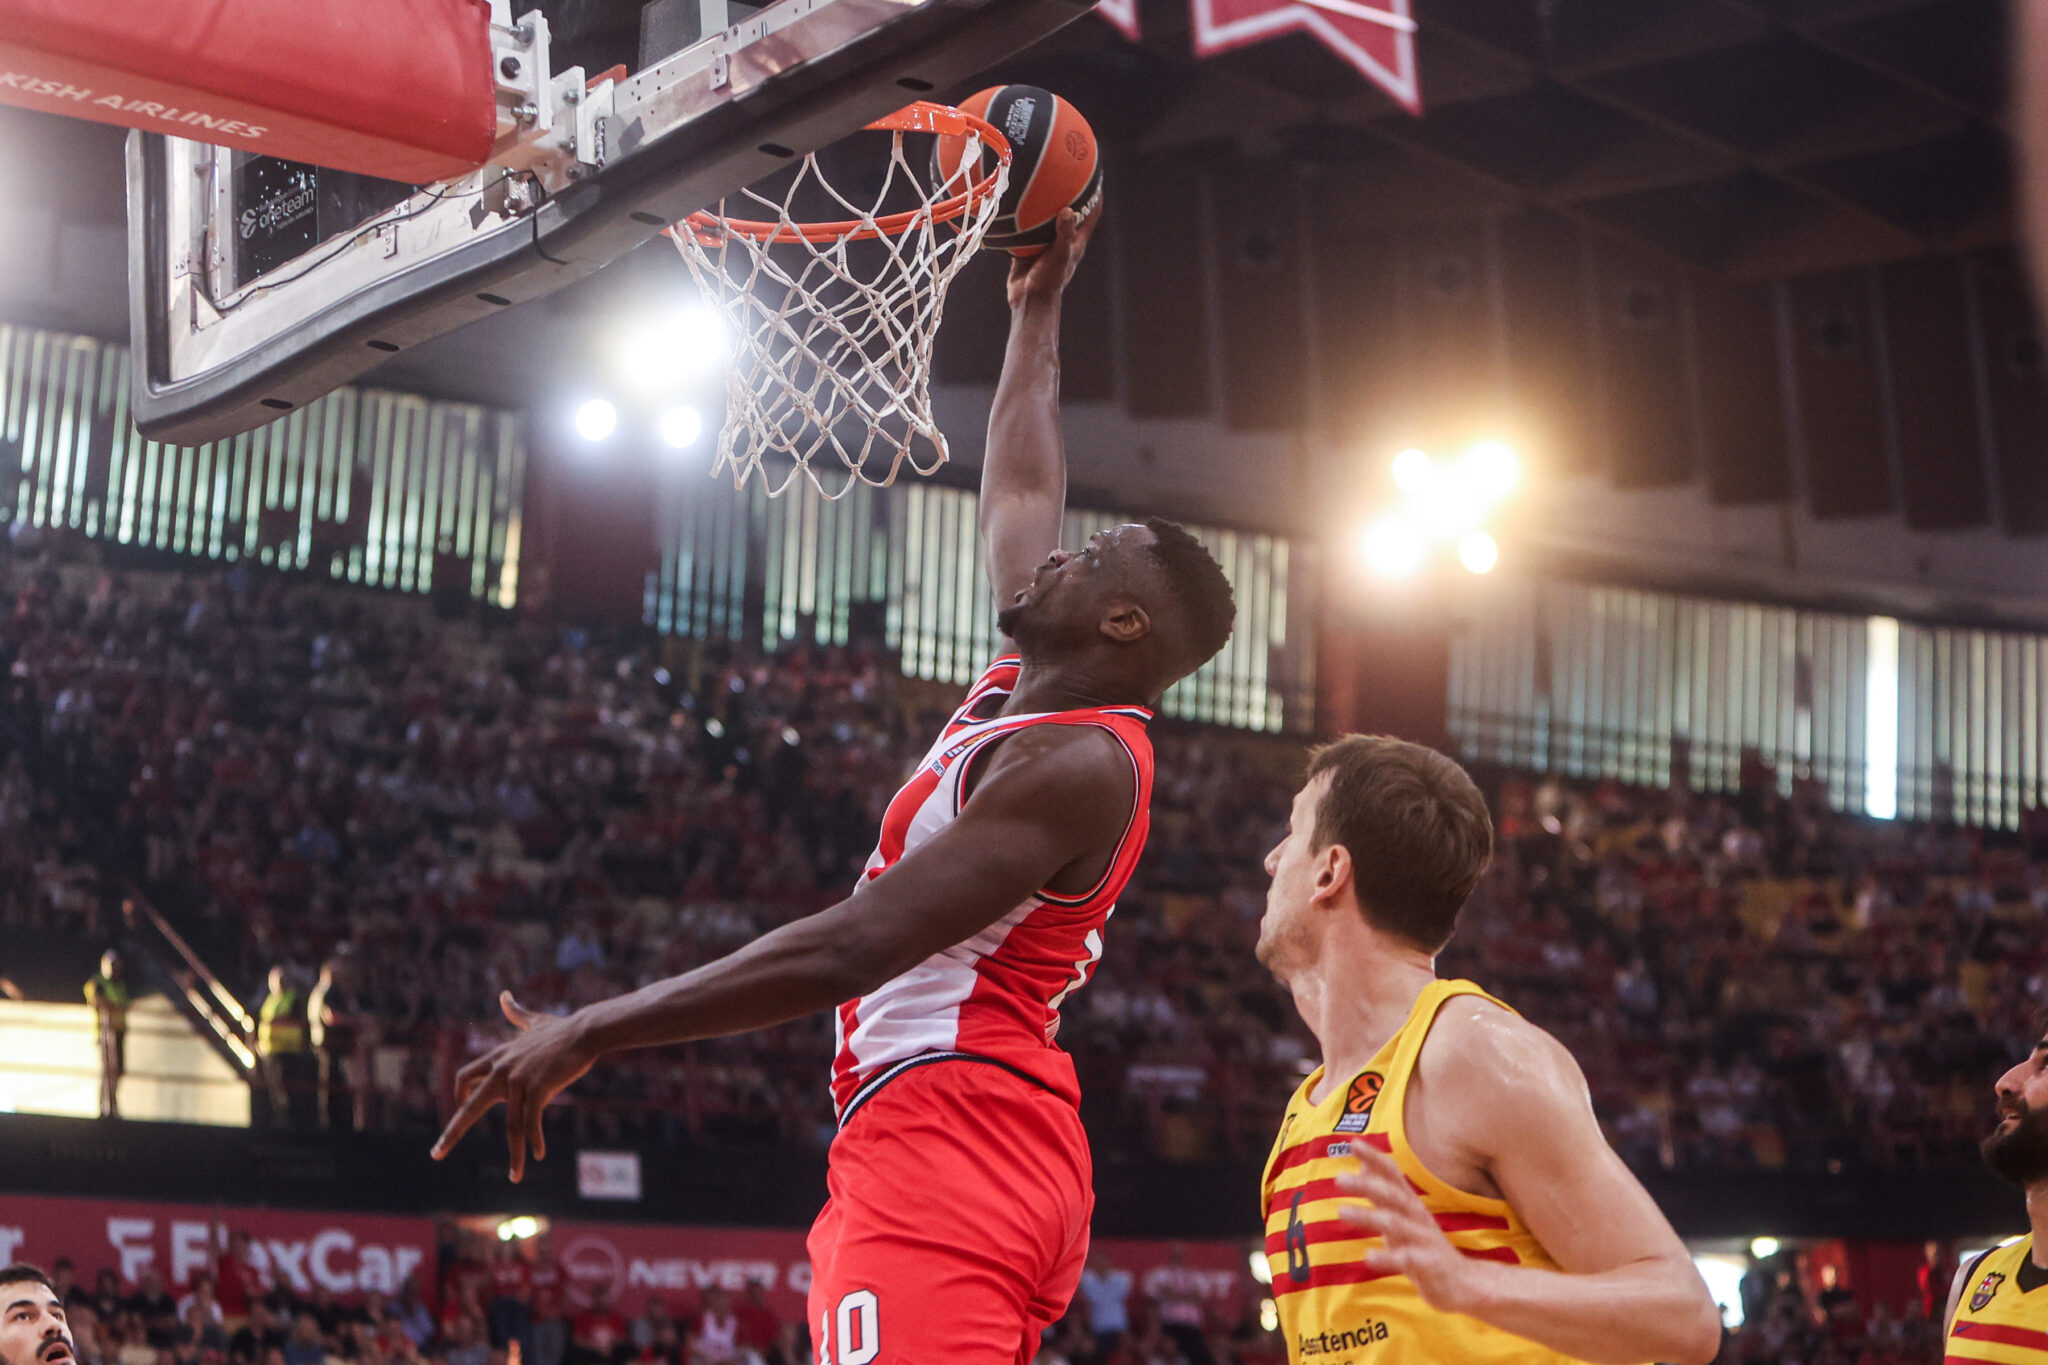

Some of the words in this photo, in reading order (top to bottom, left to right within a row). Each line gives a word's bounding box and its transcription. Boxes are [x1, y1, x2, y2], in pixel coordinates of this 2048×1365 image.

[92, 93, 269, 139] AIRLINES
[170, 1220, 423, 1297] FxCar
[1285, 1190, 1310, 1284] 6
